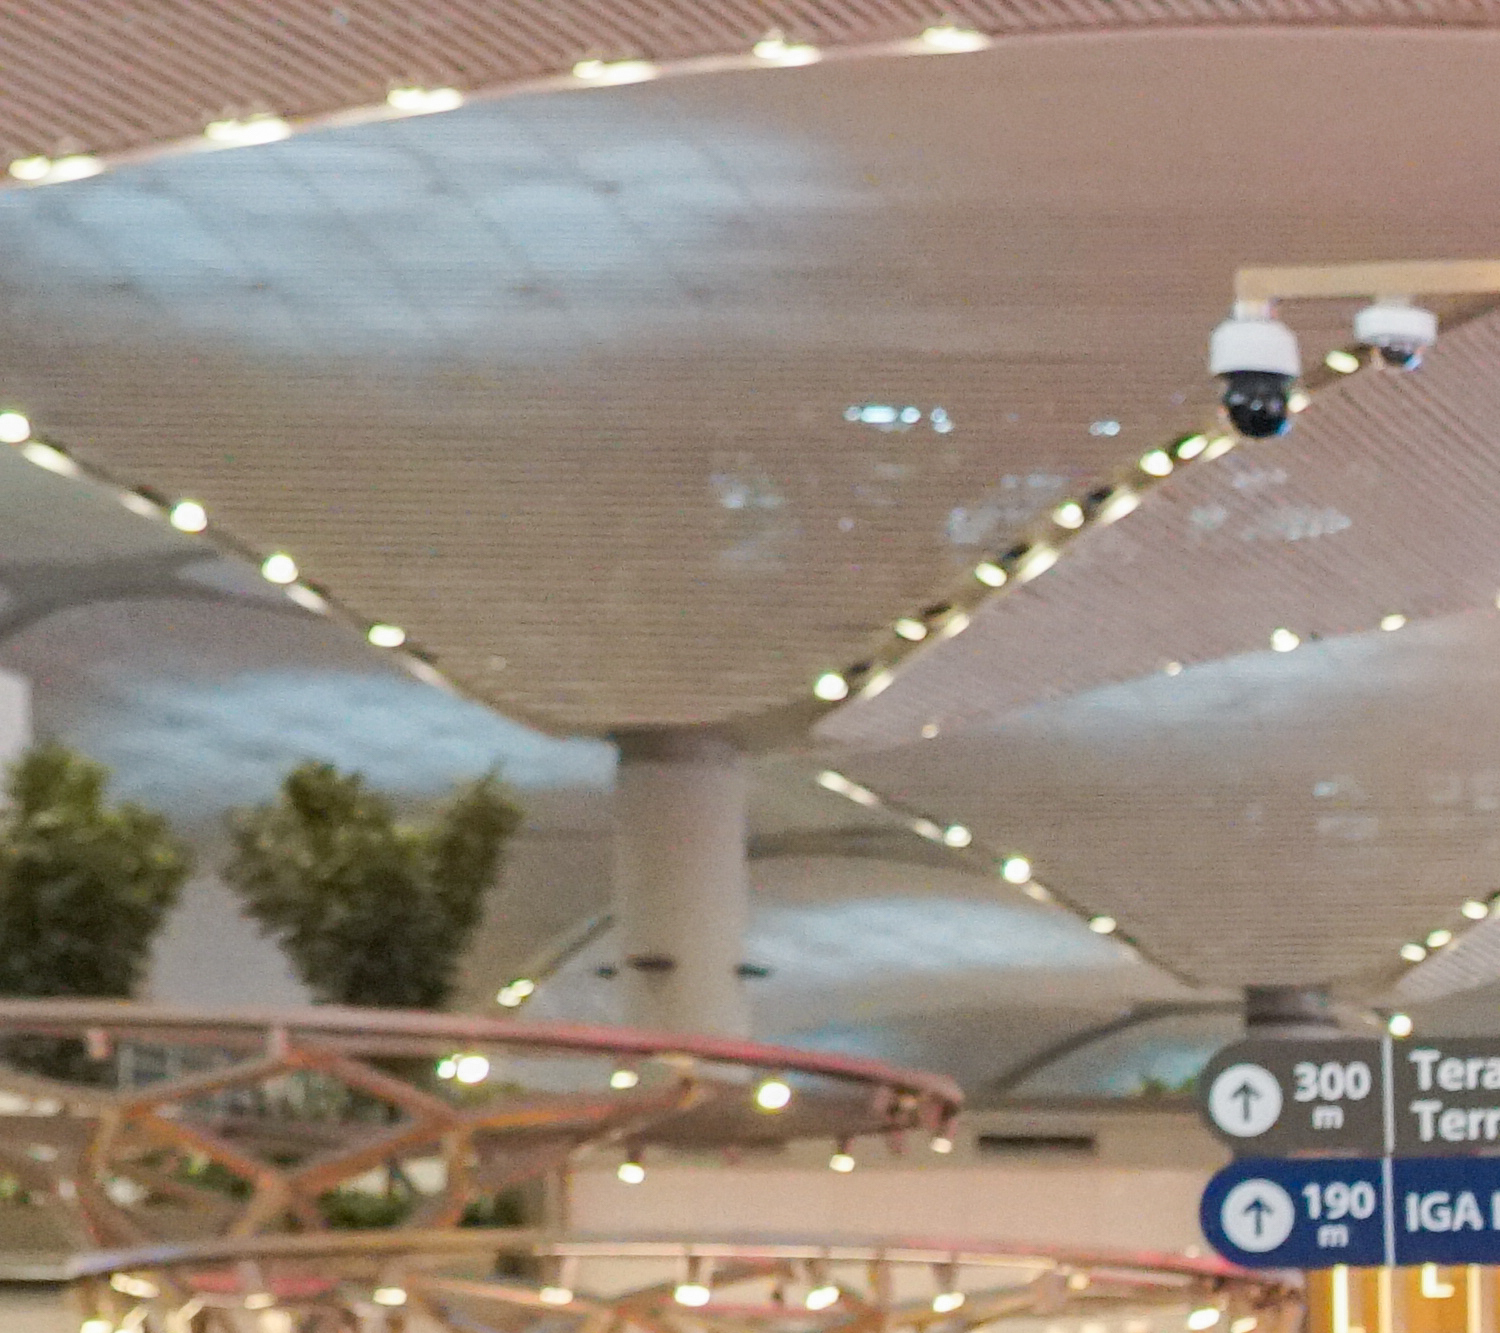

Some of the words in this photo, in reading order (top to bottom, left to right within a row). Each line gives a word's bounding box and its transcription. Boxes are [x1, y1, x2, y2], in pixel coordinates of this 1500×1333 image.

[1293, 1061, 1371, 1101] 300
[1312, 1105, 1344, 1129] m
[1302, 1181, 1376, 1220] 190
[1405, 1191, 1484, 1232] IGA
[1317, 1224, 1349, 1248] m
